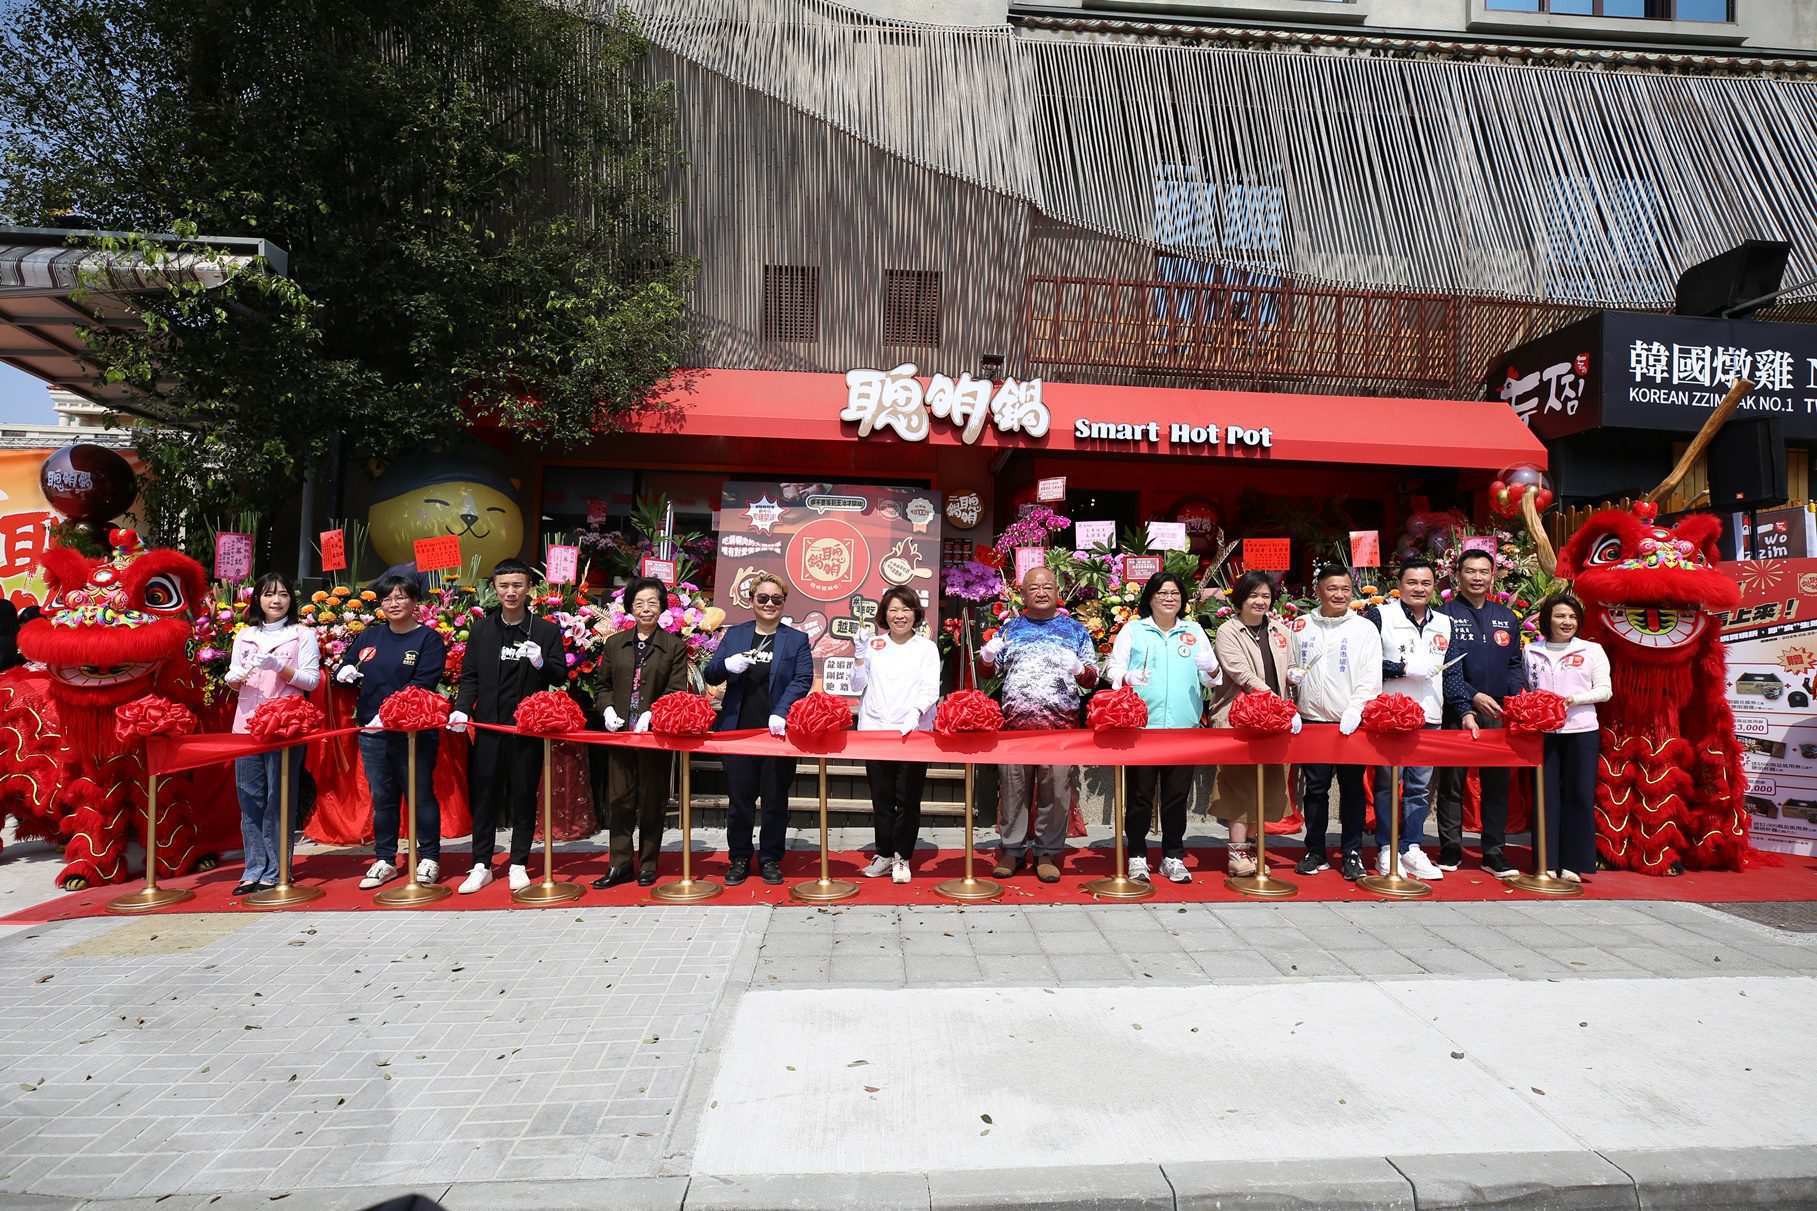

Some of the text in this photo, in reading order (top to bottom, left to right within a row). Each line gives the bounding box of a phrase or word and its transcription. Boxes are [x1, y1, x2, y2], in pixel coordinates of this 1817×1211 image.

[1629, 339, 1794, 391] 韓國燉雞
[840, 362, 1051, 445] 聰明鍋
[1629, 387, 1794, 412] KOREAN ZZIMAK NO.1
[1074, 418, 1273, 448] Smart Hot Pot
